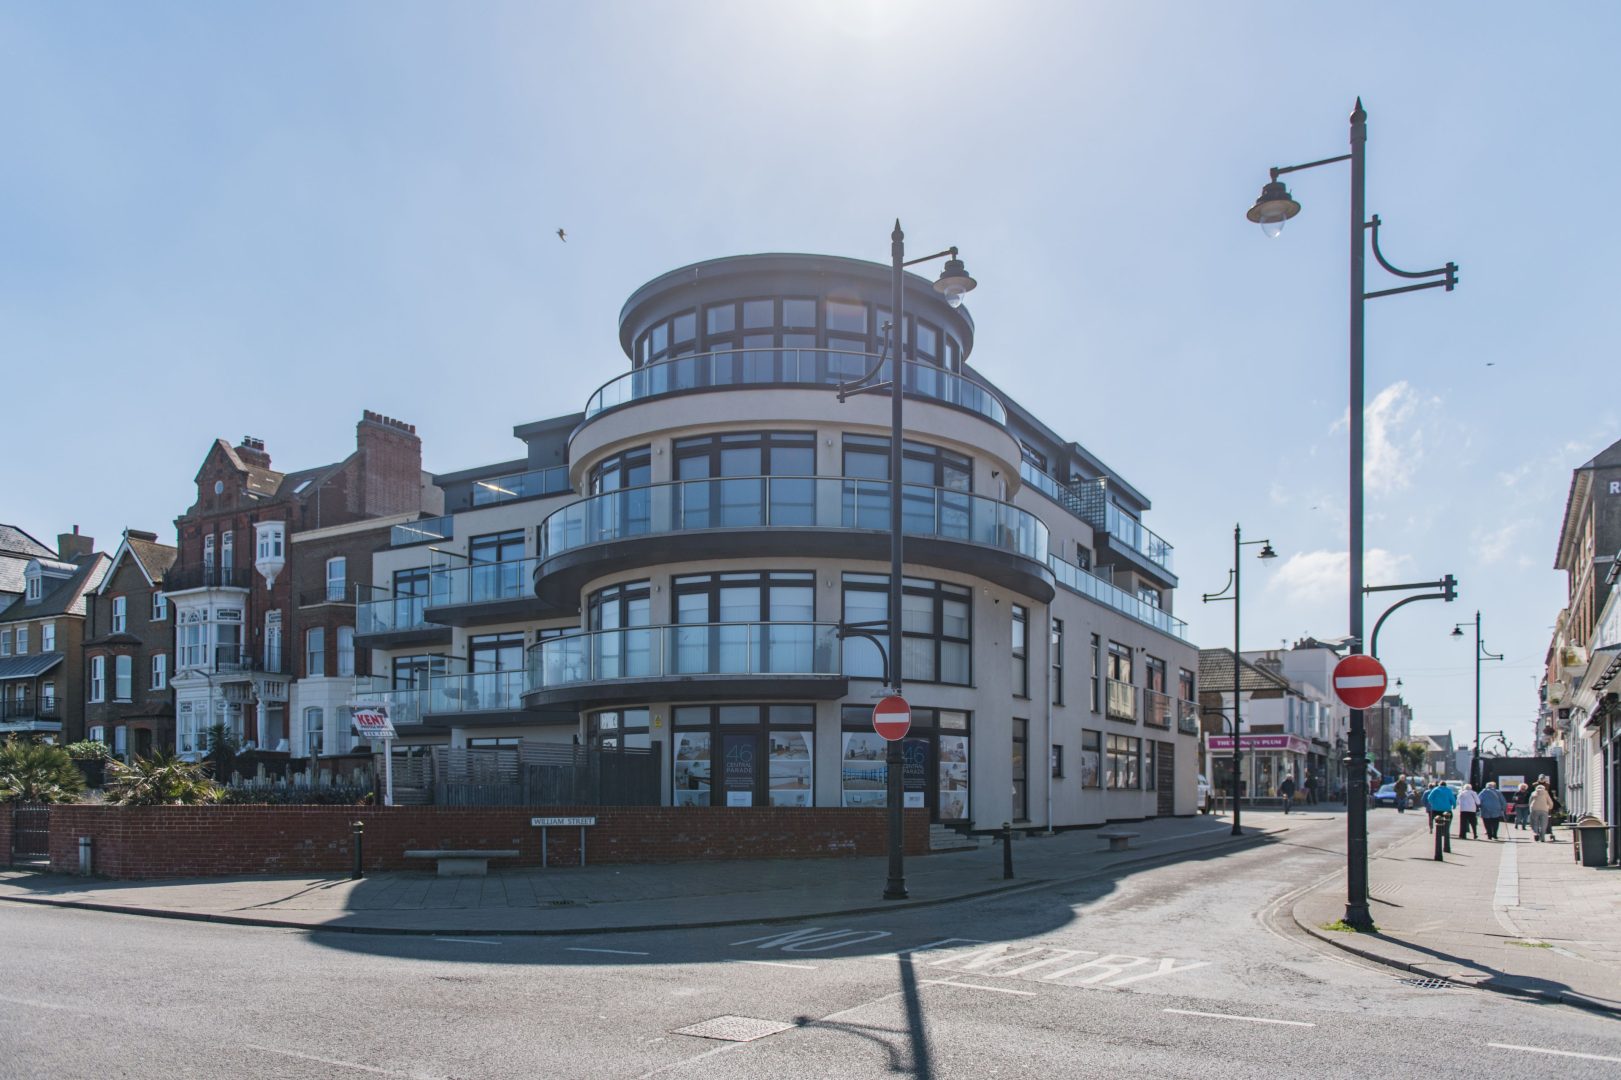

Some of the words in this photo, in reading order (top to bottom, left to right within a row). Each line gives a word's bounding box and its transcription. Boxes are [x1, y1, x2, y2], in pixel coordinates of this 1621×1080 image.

[357, 714, 385, 725] KENT
[726, 743, 752, 762] 46
[904, 746, 925, 763] 46
[729, 927, 892, 952] NO
[872, 937, 1212, 987] ENTRY
